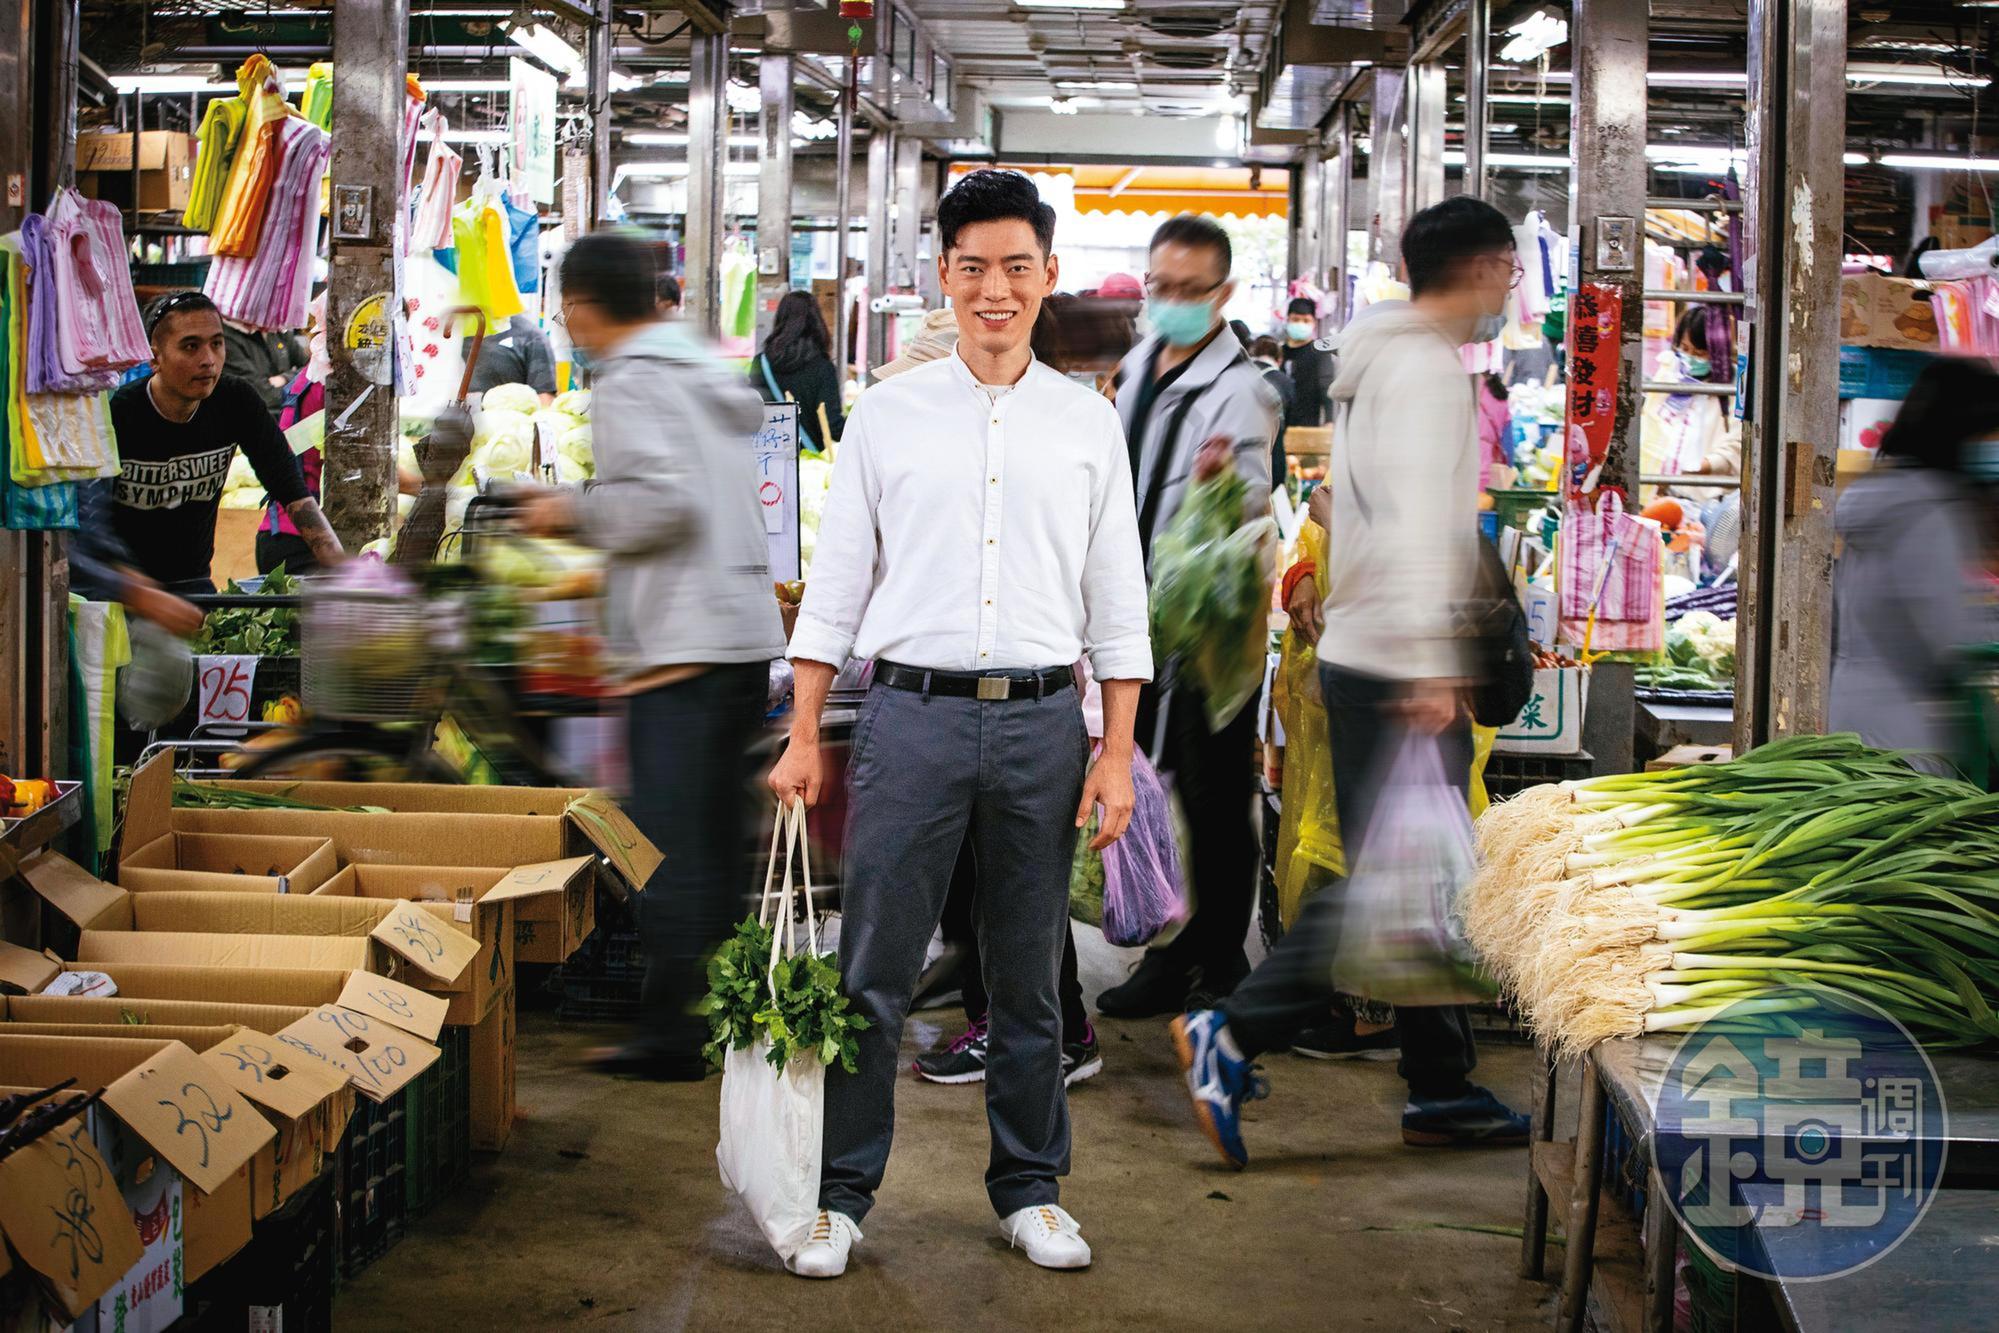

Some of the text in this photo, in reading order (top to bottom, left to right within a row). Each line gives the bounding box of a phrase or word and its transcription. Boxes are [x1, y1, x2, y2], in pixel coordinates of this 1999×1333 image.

[1572, 292, 1600, 418] 恭喜發財
[201, 661, 250, 721] 25
[318, 1010, 368, 1042] 90
[368, 988, 414, 1019] 60
[356, 1045, 406, 1087] 100
[158, 1082, 233, 1169] 32
